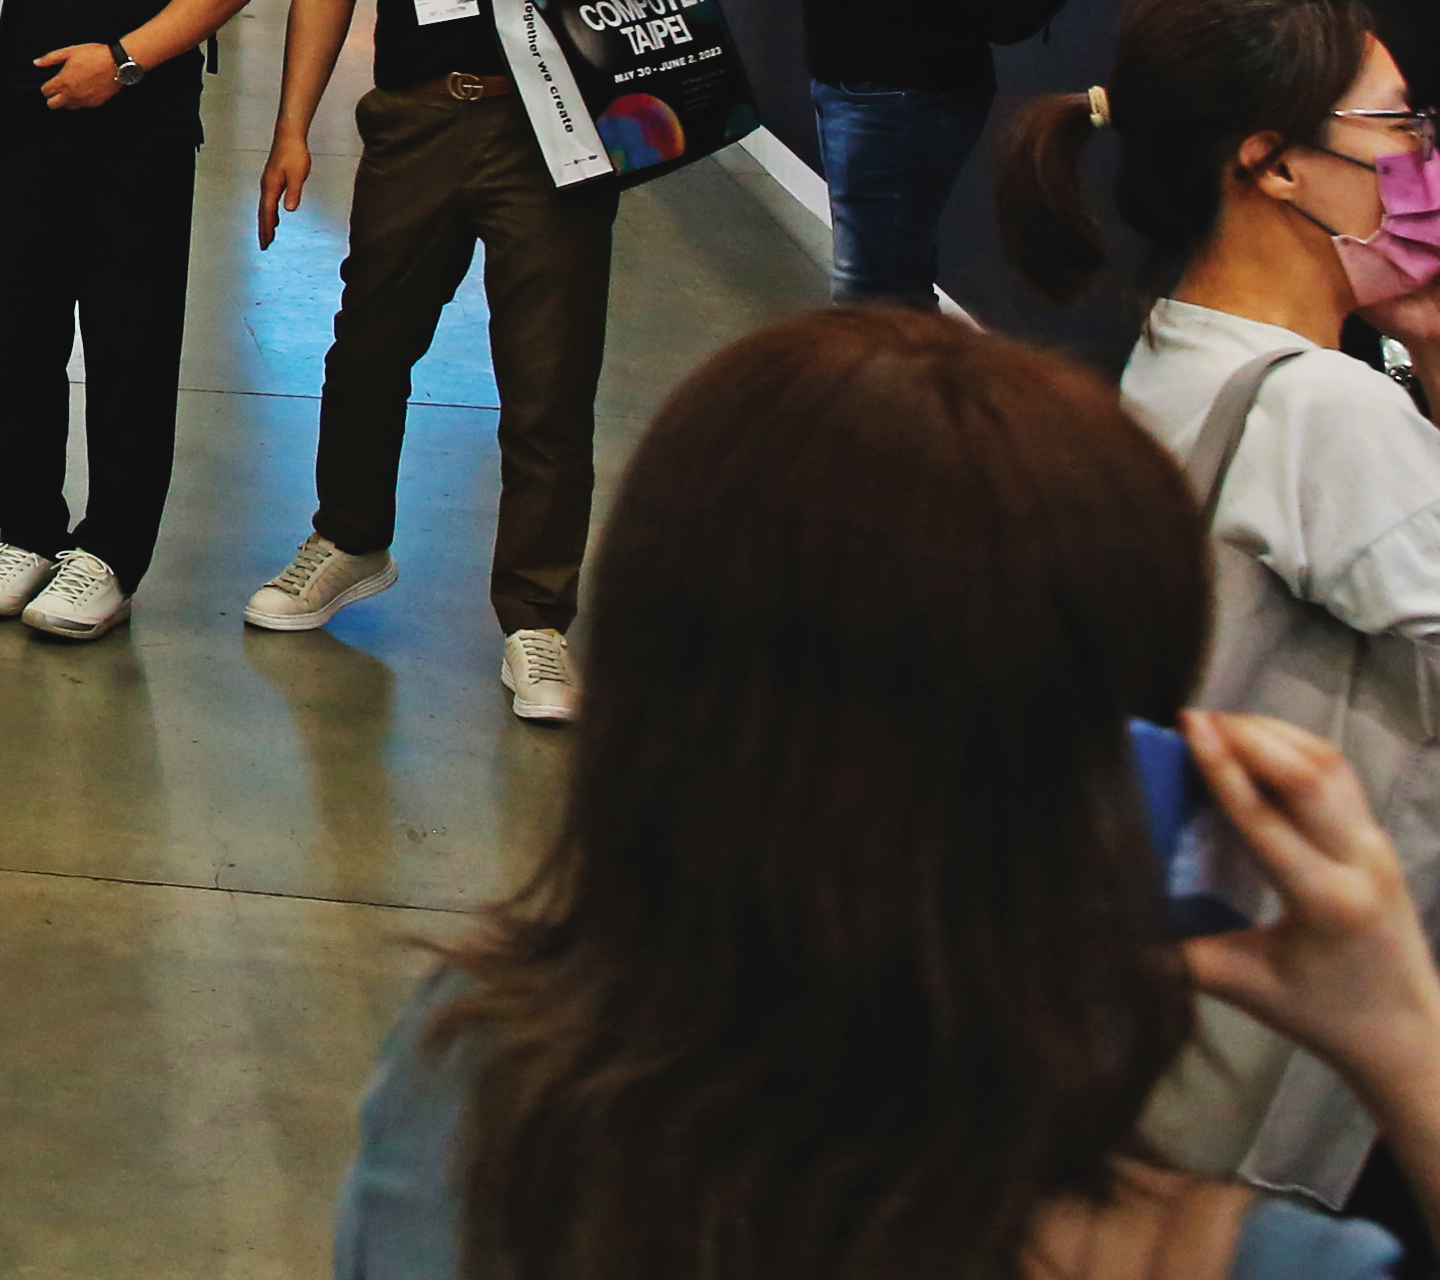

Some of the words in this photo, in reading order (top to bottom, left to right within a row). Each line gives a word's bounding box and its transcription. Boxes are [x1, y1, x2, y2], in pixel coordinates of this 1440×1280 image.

[619, 14, 694, 56] TAIPEI
[637, 66, 651, 78] 30
[659, 58, 686, 72] JUNE
[699, 46, 722, 61] 2023
[549, 85, 575, 134] create
